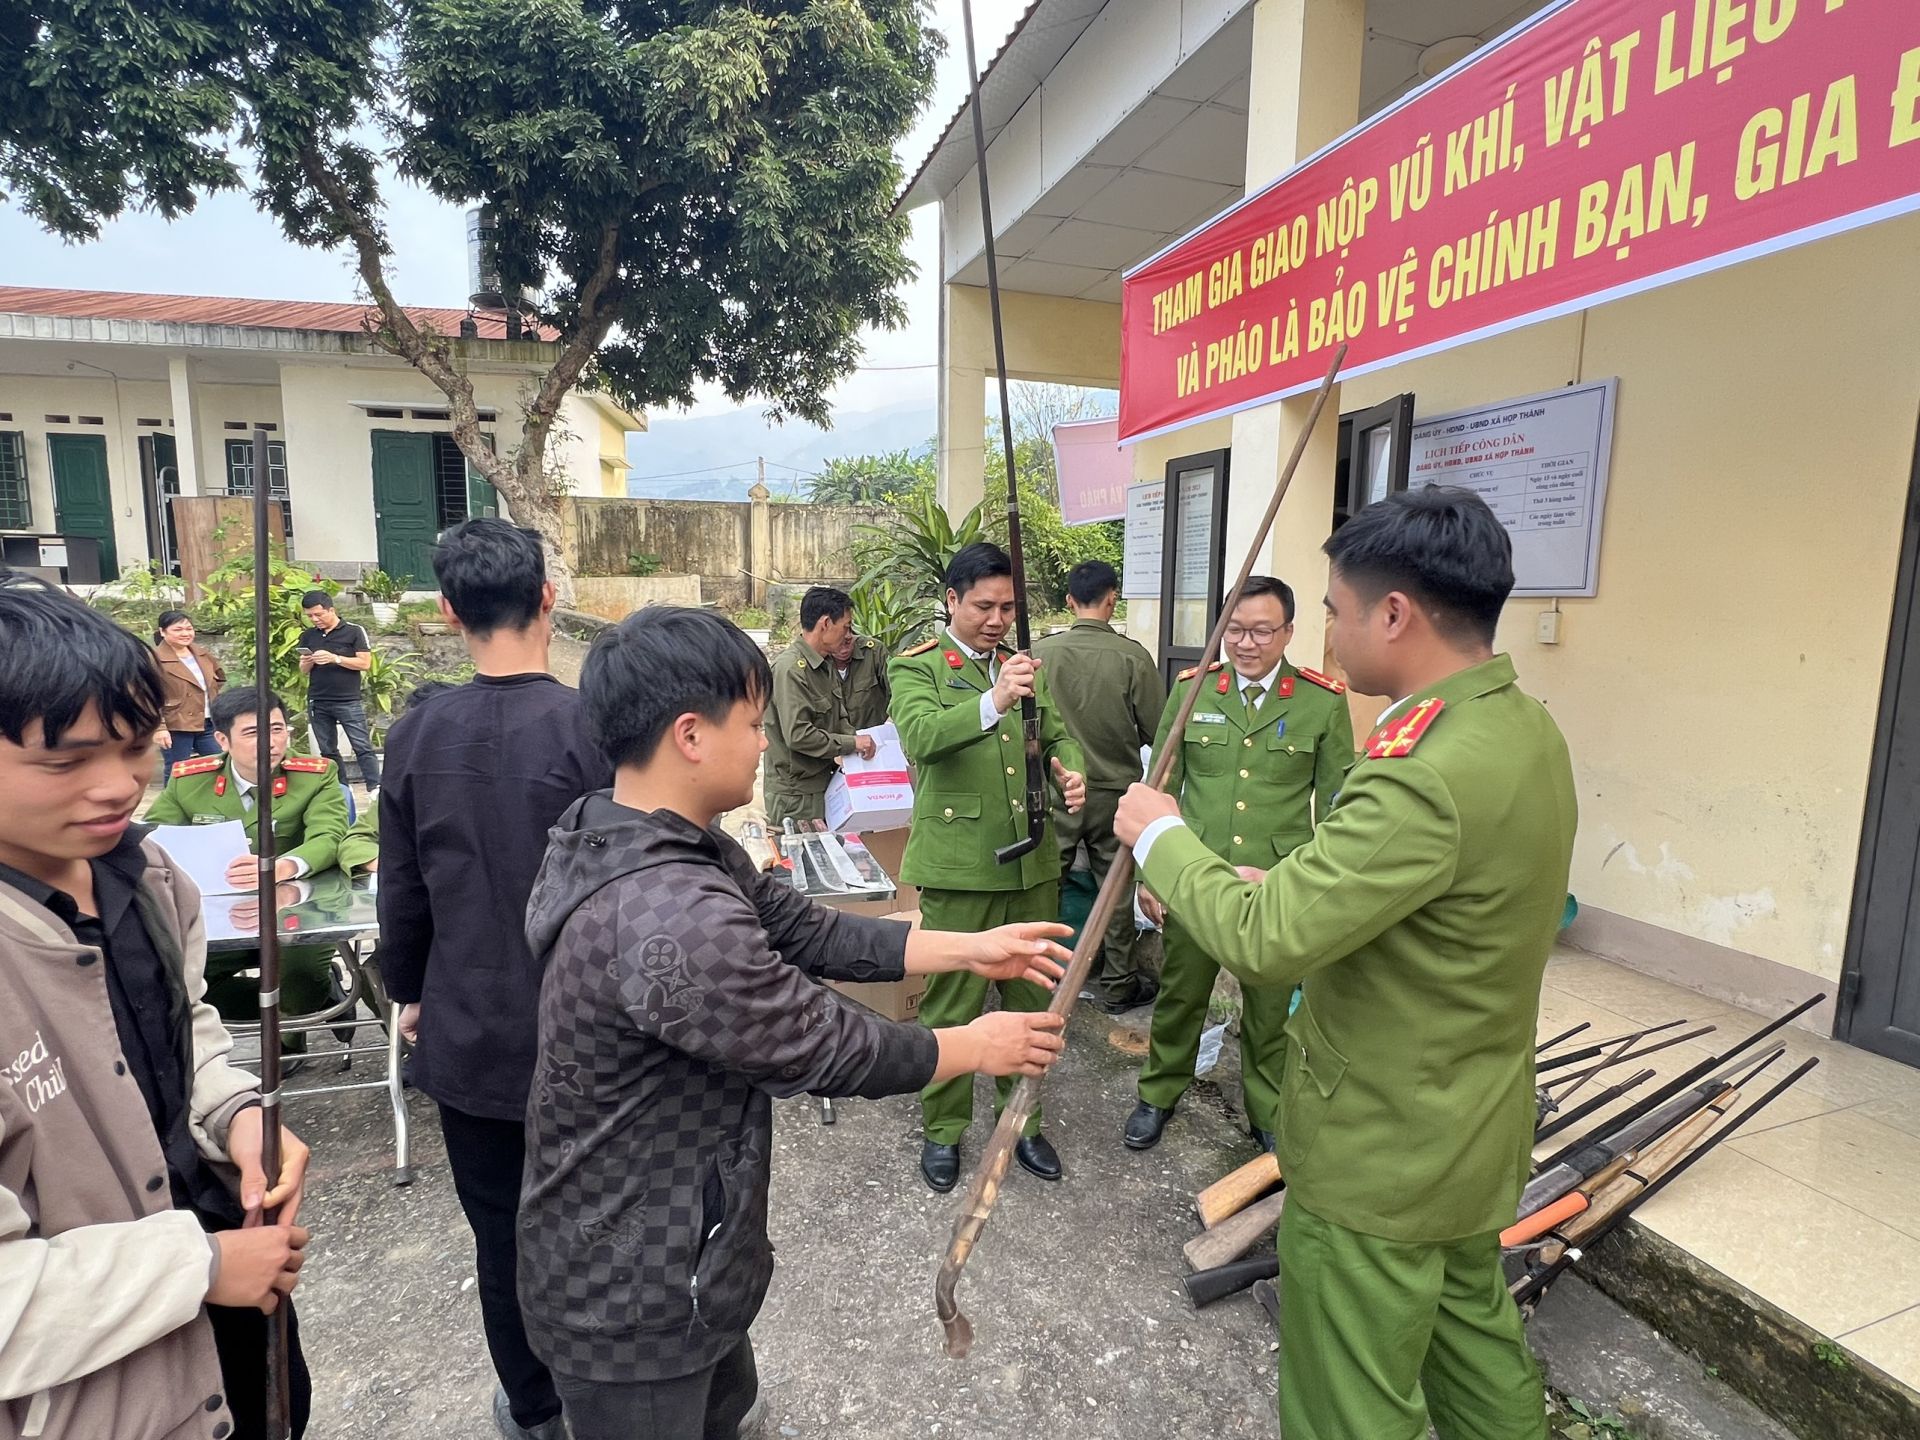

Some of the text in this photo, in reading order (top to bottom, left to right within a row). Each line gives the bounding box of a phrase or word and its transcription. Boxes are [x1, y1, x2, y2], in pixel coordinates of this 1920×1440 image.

[1152, 270, 1203, 336] THAM
[1208, 250, 1243, 310] GIA
[1249, 214, 1309, 290] GIAO
[1315, 176, 1378, 259] NỘP
[1389, 132, 1434, 223] VŨ
[1443, 82, 1525, 197] KHÍ,
[1544, 29, 1641, 149] VẬT
[1176, 341, 1200, 399] VÀ
[1204, 319, 1264, 389] PHÁO
[1269, 298, 1300, 366] LÀ
[1307, 265, 1367, 353] BẢO
[1377, 246, 1418, 334] VỆ
[1427, 196, 1561, 310] CHÍNH
[1572, 140, 1709, 262] BẠN,
[1734, 73, 1858, 201] GIA
[1450, 440, 1471, 456] TIẾP
[1472, 438, 1500, 451] CÔNG
[1503, 433, 1525, 446] DÂN
[1470, 419, 1489, 430] UBND
